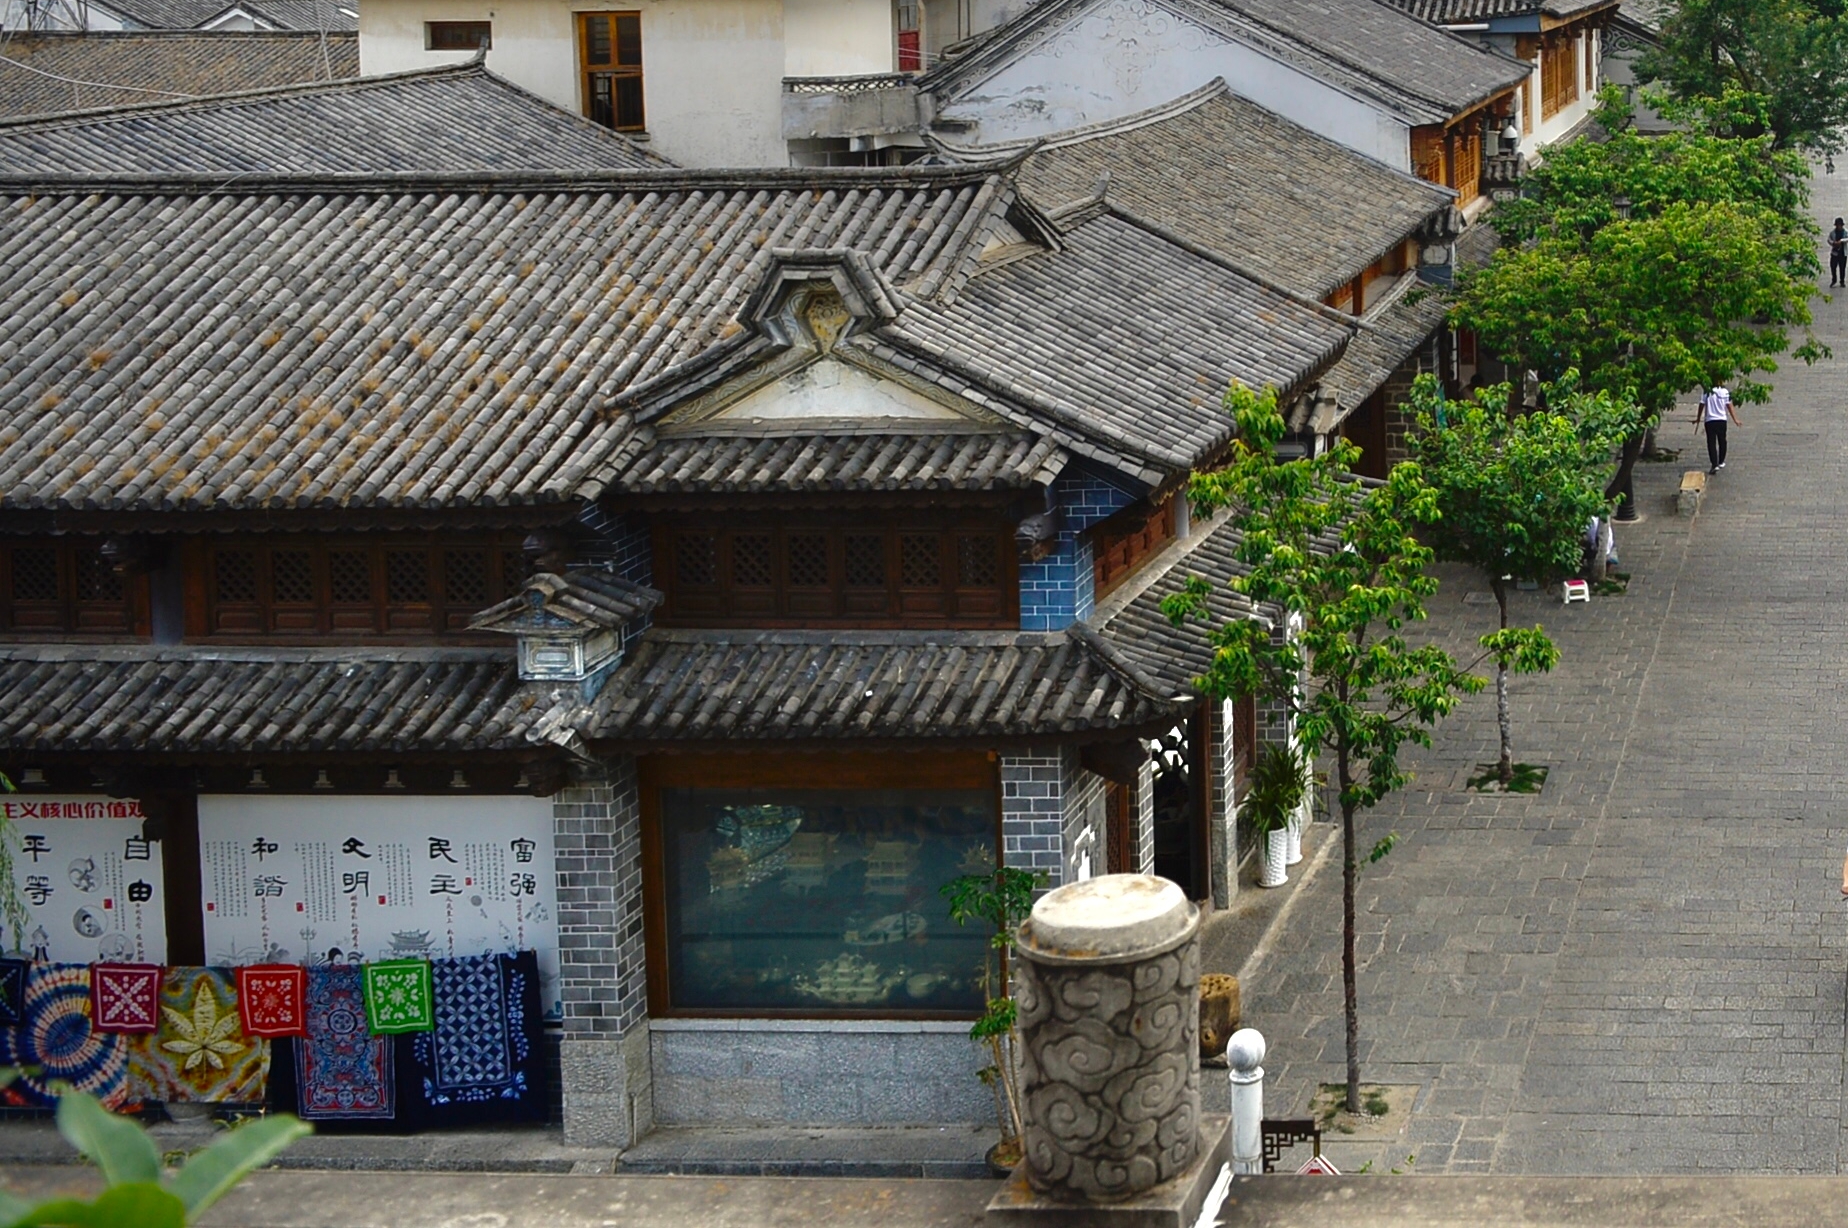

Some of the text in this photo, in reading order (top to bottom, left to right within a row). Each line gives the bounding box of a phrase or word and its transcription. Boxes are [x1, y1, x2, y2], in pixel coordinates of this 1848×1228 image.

[22, 834, 54, 906] 平等
[124, 834, 153, 903] 自由
[342, 837, 372, 897] 文明
[428, 836, 463, 895] 民主
